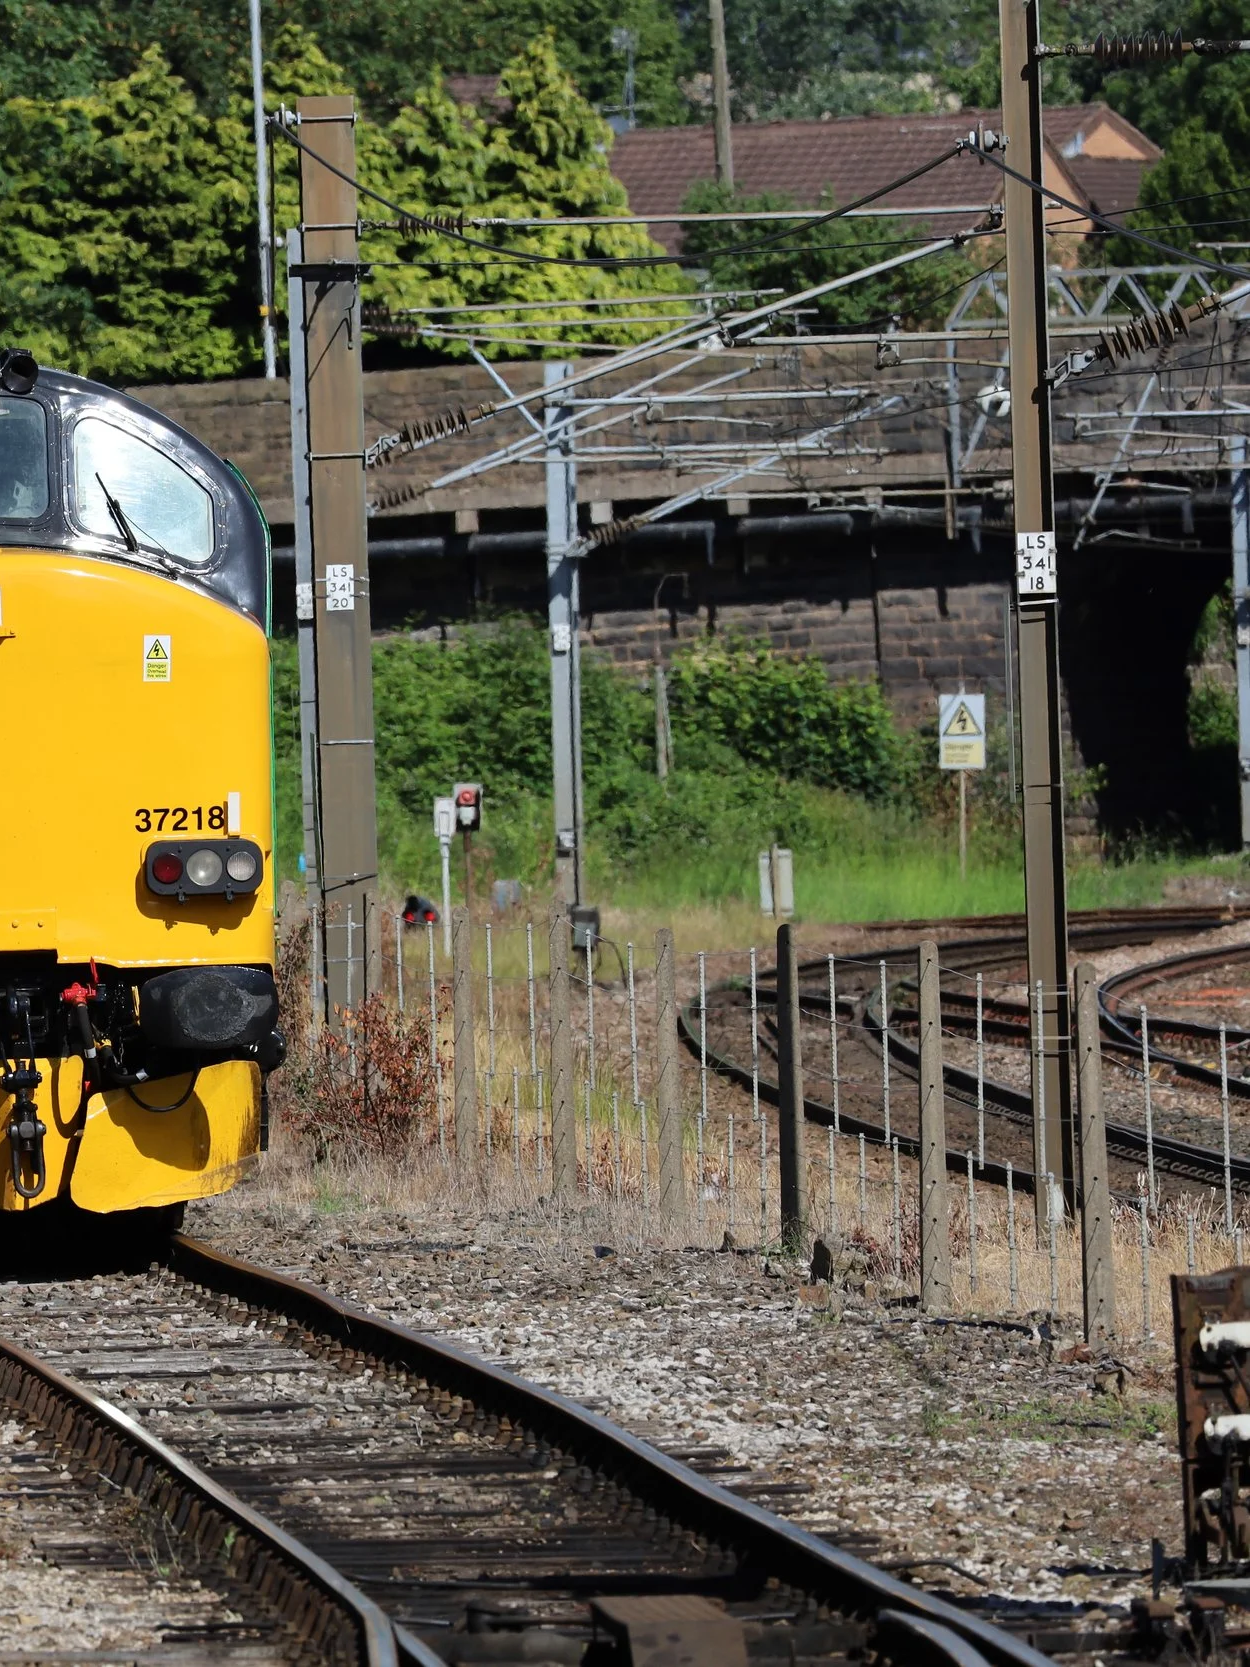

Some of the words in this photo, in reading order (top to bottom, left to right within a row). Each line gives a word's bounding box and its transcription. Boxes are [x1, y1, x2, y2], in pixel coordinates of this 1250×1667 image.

[1026, 535, 1046, 549] LS
[1023, 556, 1051, 570] 341
[332, 567, 348, 577] LS
[330, 582, 351, 593] 341
[1030, 576, 1045, 590] 18
[332, 598, 349, 608] 20
[135, 805, 225, 832] 37218
